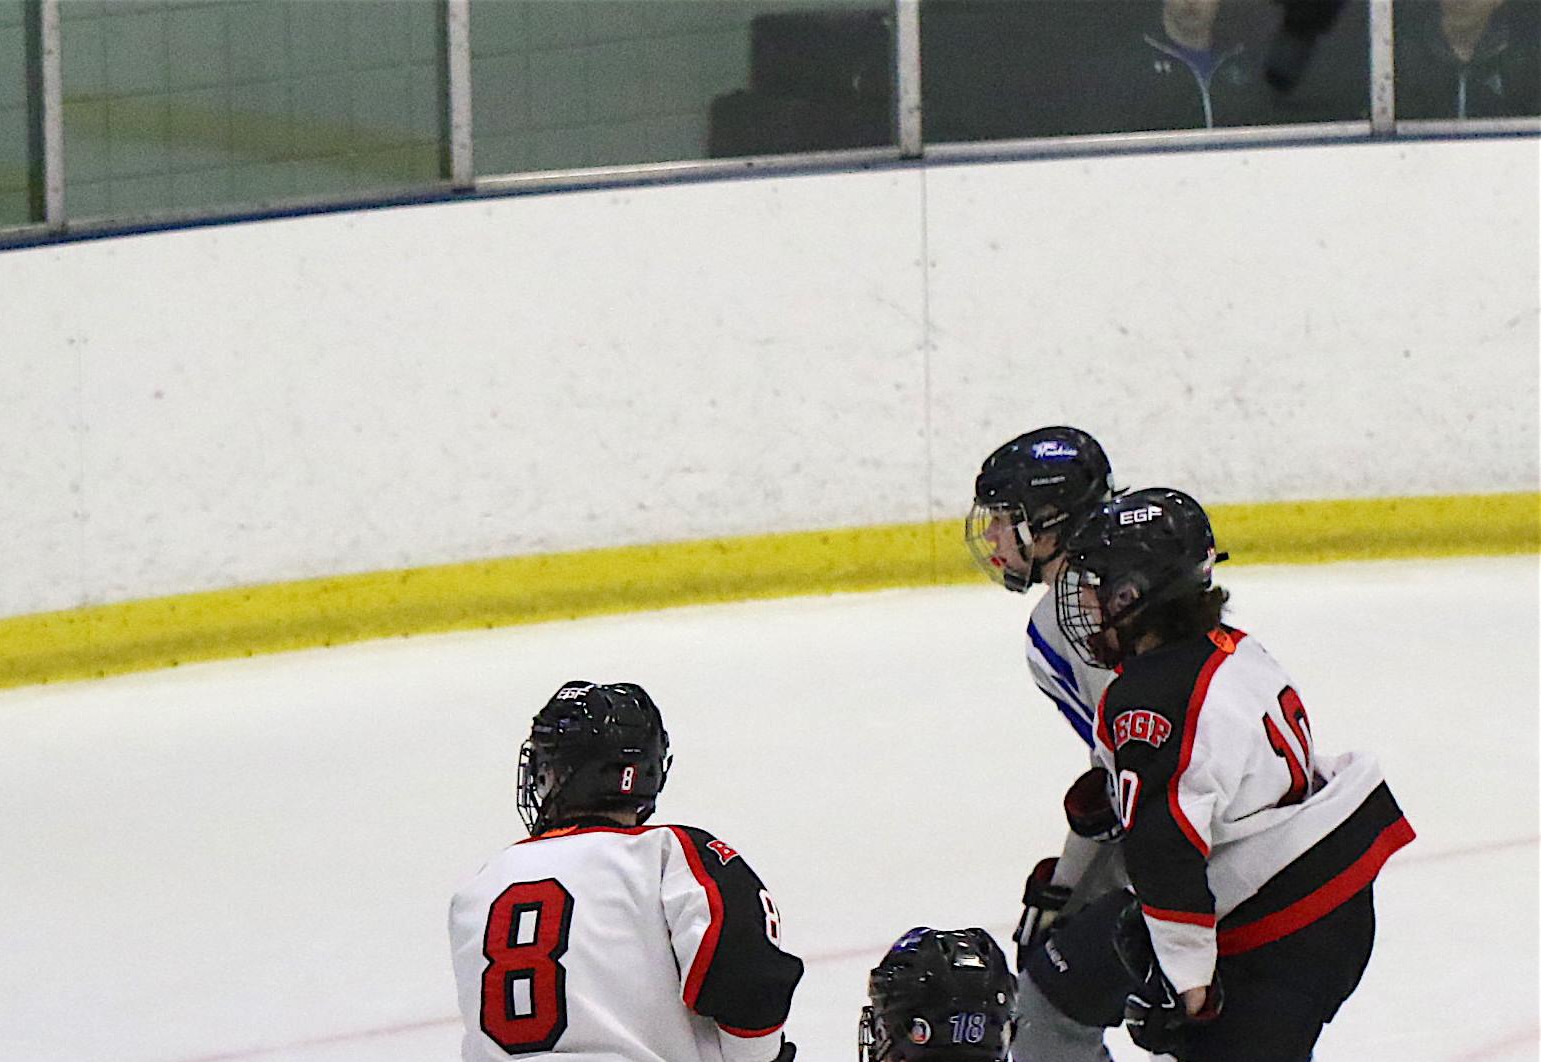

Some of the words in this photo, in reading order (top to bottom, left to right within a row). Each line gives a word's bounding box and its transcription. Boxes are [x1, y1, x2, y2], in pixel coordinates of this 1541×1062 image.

[1119, 504, 1162, 525] EGF
[1113, 709, 1172, 751] EGF
[620, 764, 637, 793] 8
[481, 878, 575, 1055] 8
[948, 1011, 987, 1045] 18
